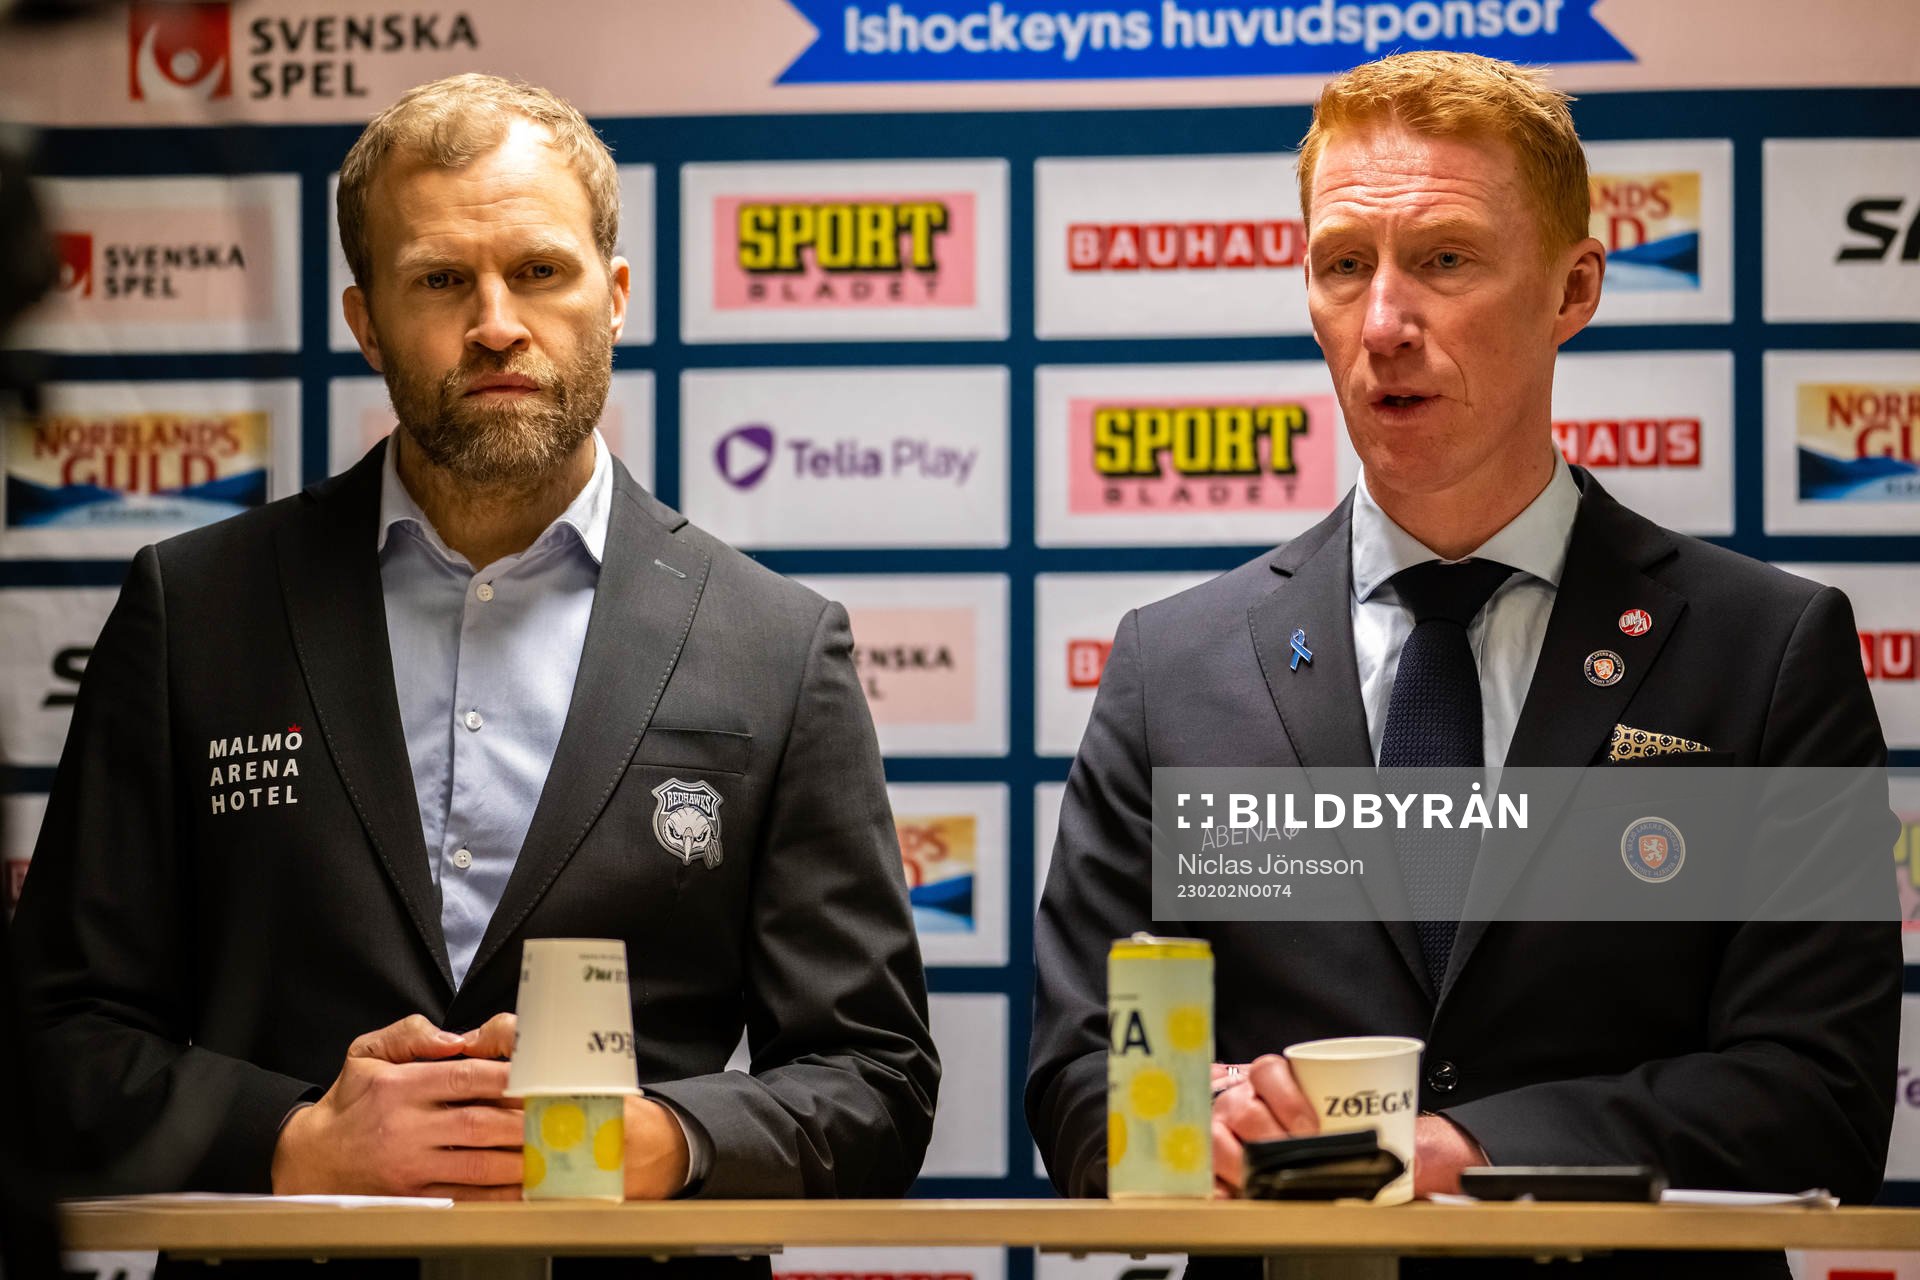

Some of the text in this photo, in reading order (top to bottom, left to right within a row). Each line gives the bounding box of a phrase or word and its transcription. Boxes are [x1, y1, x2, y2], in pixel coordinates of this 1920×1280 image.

[250, 13, 478, 54] SVENSKA
[845, 0, 1561, 61] Ishockeyns huvudsponsor
[250, 60, 367, 98] SPEL
[105, 244, 246, 270] SVENSKA
[739, 202, 950, 275] SPORT
[1071, 223, 1304, 268] BAUHAU
[105, 276, 178, 299] SPEL
[748, 282, 938, 300] BLADET
[34, 417, 240, 457] NORRLANDS
[1094, 405, 1308, 477] SPORT
[1552, 424, 1697, 463] HAUS
[61, 453, 217, 494] GULD
[788, 437, 978, 487] Telia Play
[1104, 484, 1298, 505] BLADET
[852, 645, 956, 672] NSKA
[210, 758, 299, 787] ARENA
[211, 785, 298, 815] HOTEL
[666, 791, 711, 815] REDHAWKS
[1202, 820, 1281, 851] ABENA
